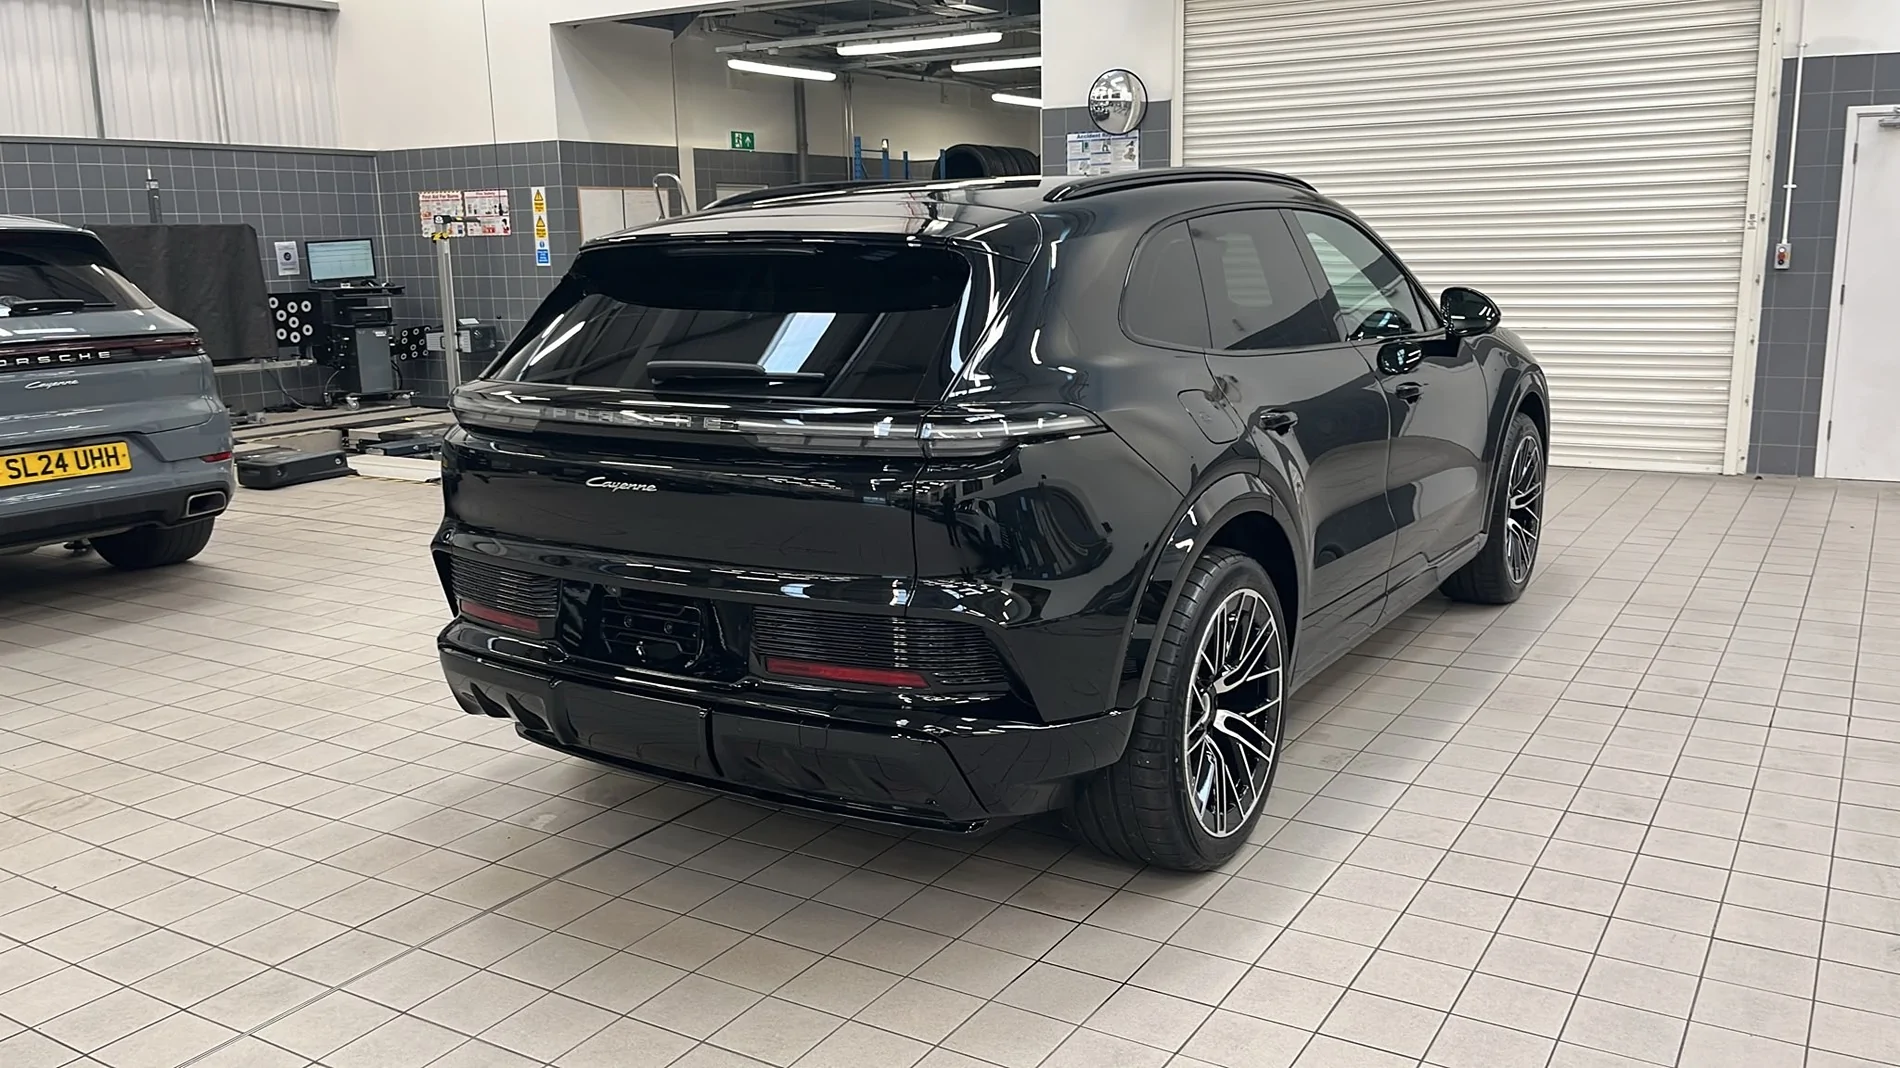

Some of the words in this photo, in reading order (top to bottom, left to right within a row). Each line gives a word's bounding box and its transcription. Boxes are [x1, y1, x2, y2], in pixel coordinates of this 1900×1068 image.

[24, 379, 79, 390] Cayenne
[5, 452, 69, 480] SL24
[74, 446, 121, 471] UHH
[585, 476, 658, 493] Cayenne
